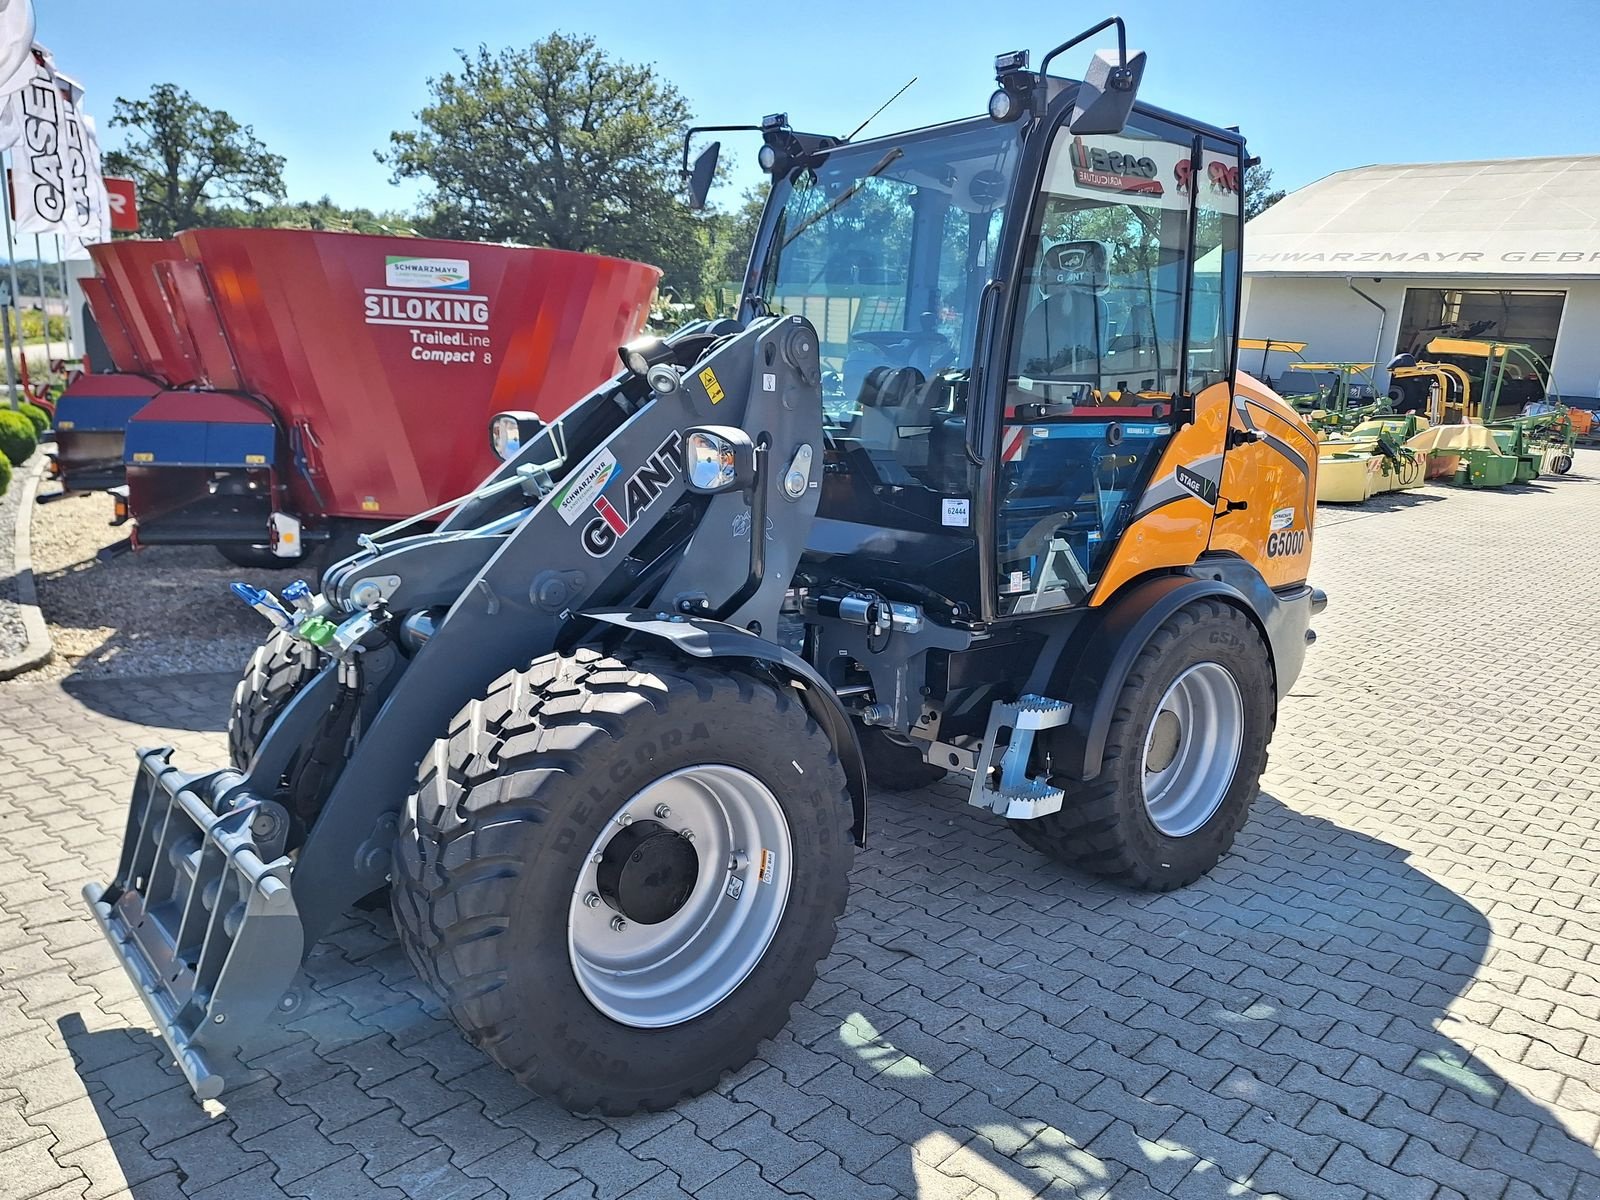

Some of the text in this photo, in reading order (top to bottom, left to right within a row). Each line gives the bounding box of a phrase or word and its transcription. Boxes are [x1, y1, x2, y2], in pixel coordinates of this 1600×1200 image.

[394, 263, 458, 274] SCHWARZMAYR
[1056, 272, 1085, 282] GANT
[364, 296, 489, 323] SILOKING
[409, 329, 490, 348] TrailedLine
[411, 346, 492, 365] Compact 8
[562, 461, 607, 508] SCHWARZMAYR
[1179, 472, 1201, 493] STAGE
[947, 507, 966, 515] 62444
[1266, 530, 1305, 558] G5000
[553, 722, 711, 853] DELCORA
